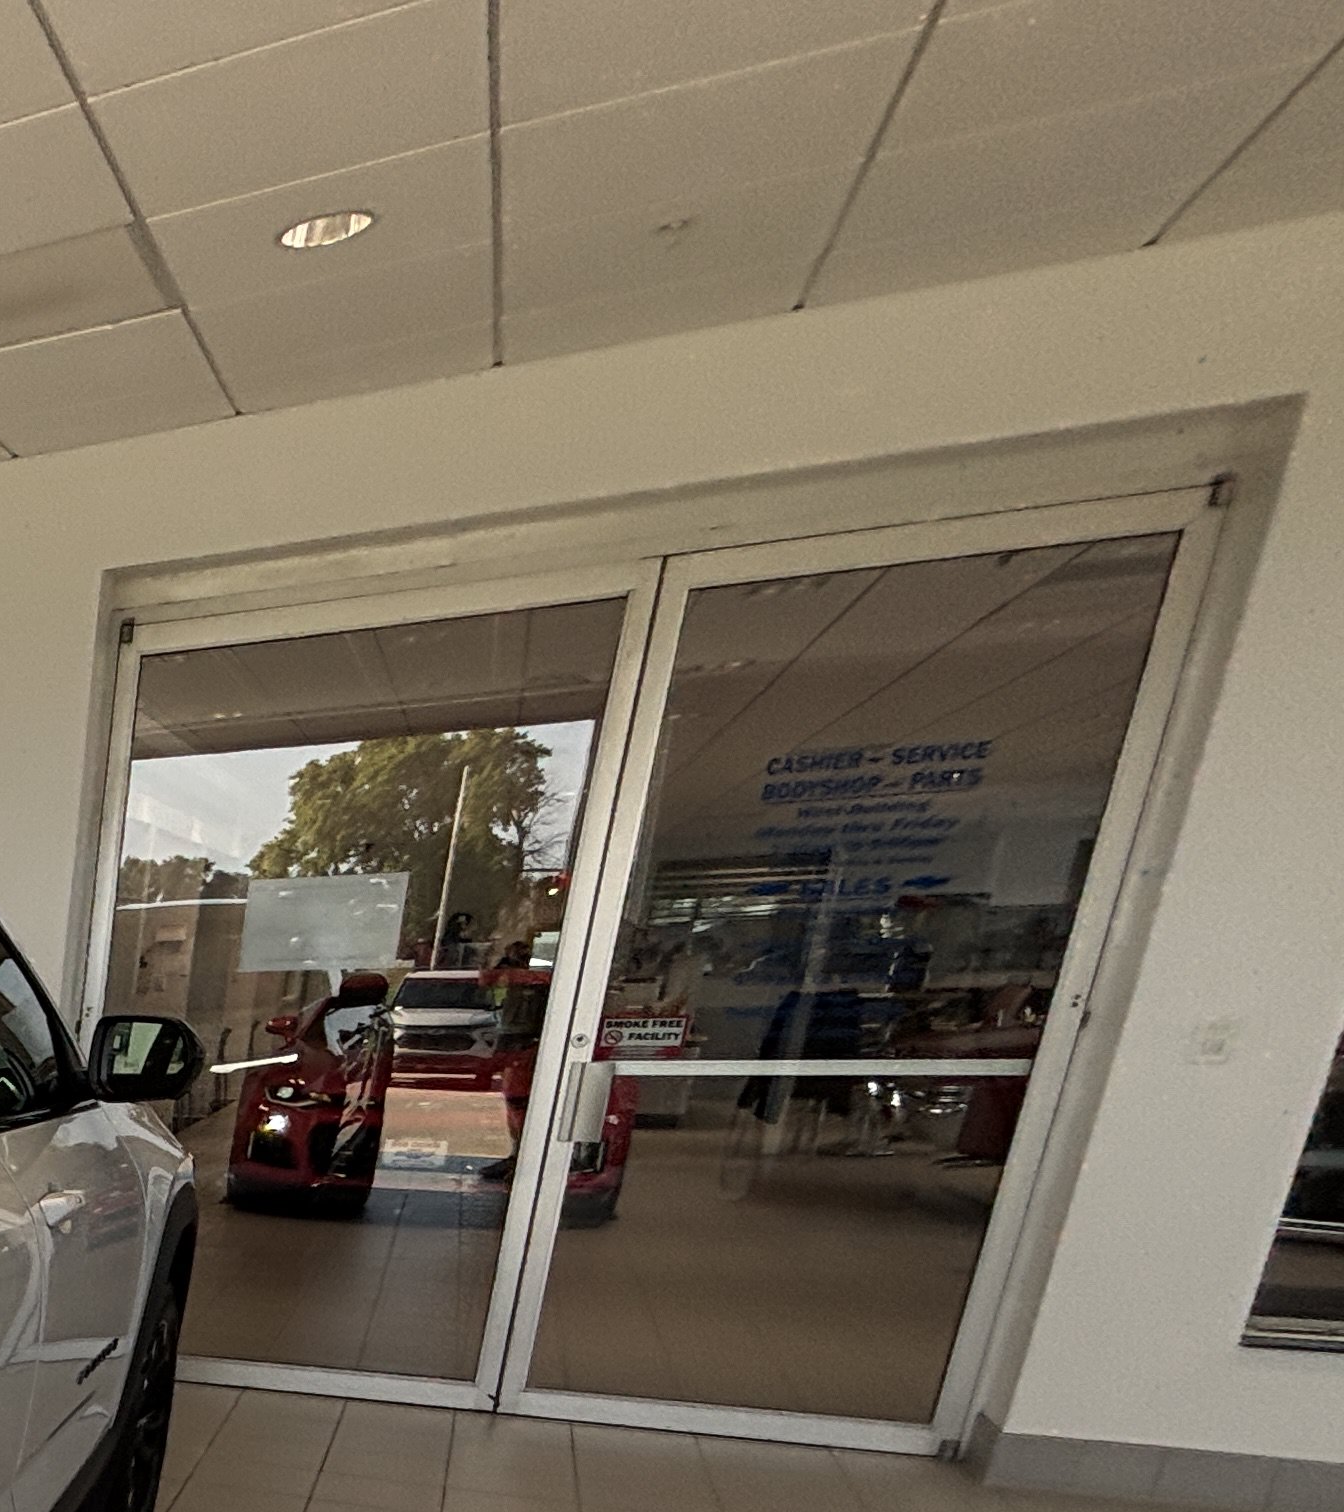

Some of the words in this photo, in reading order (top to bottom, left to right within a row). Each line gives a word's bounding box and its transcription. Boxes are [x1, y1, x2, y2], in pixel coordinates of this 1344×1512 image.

[766, 751, 863, 775] CASHIER
[891, 740, 993, 765] SERVICE
[761, 775, 882, 801] BODYSHOP
[909, 767, 984, 790] PARTS
[890, 814, 960, 831] Friday
[605, 1020, 649, 1029] SMOKE
[652, 1019, 683, 1028] FREE
[627, 1032, 680, 1041] FACILITY
